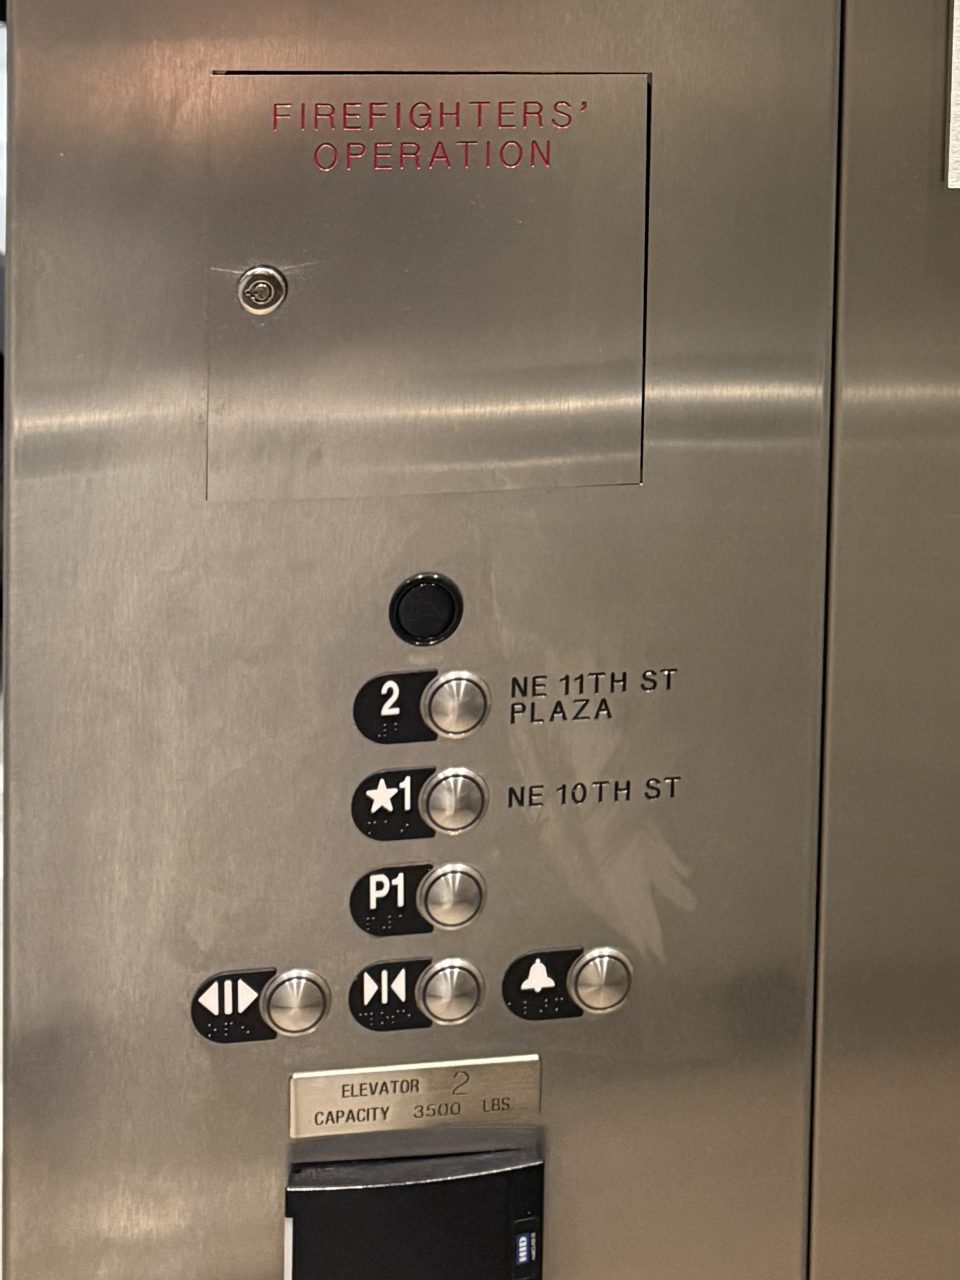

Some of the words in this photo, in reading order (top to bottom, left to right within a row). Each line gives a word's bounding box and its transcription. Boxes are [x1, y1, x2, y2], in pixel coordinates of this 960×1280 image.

[313, 140, 552, 172] OPERATION
[380, 680, 401, 717] 2
[510, 675, 548, 699] NE
[559, 671, 628, 697] 11TH
[640, 668, 678, 693] ST
[509, 698, 613, 725] PLAZA
[507, 784, 545, 809] NE
[556, 780, 632, 806] 10TH
[643, 776, 682, 801] ST
[368, 872, 405, 910] P1
[341, 1078, 420, 1099] ELEVATOR
[452, 1071, 471, 1096] 2
[313, 1106, 390, 1126] CAPACITY
[413, 1101, 462, 1119] 3500
[482, 1096, 511, 1114] LBS
